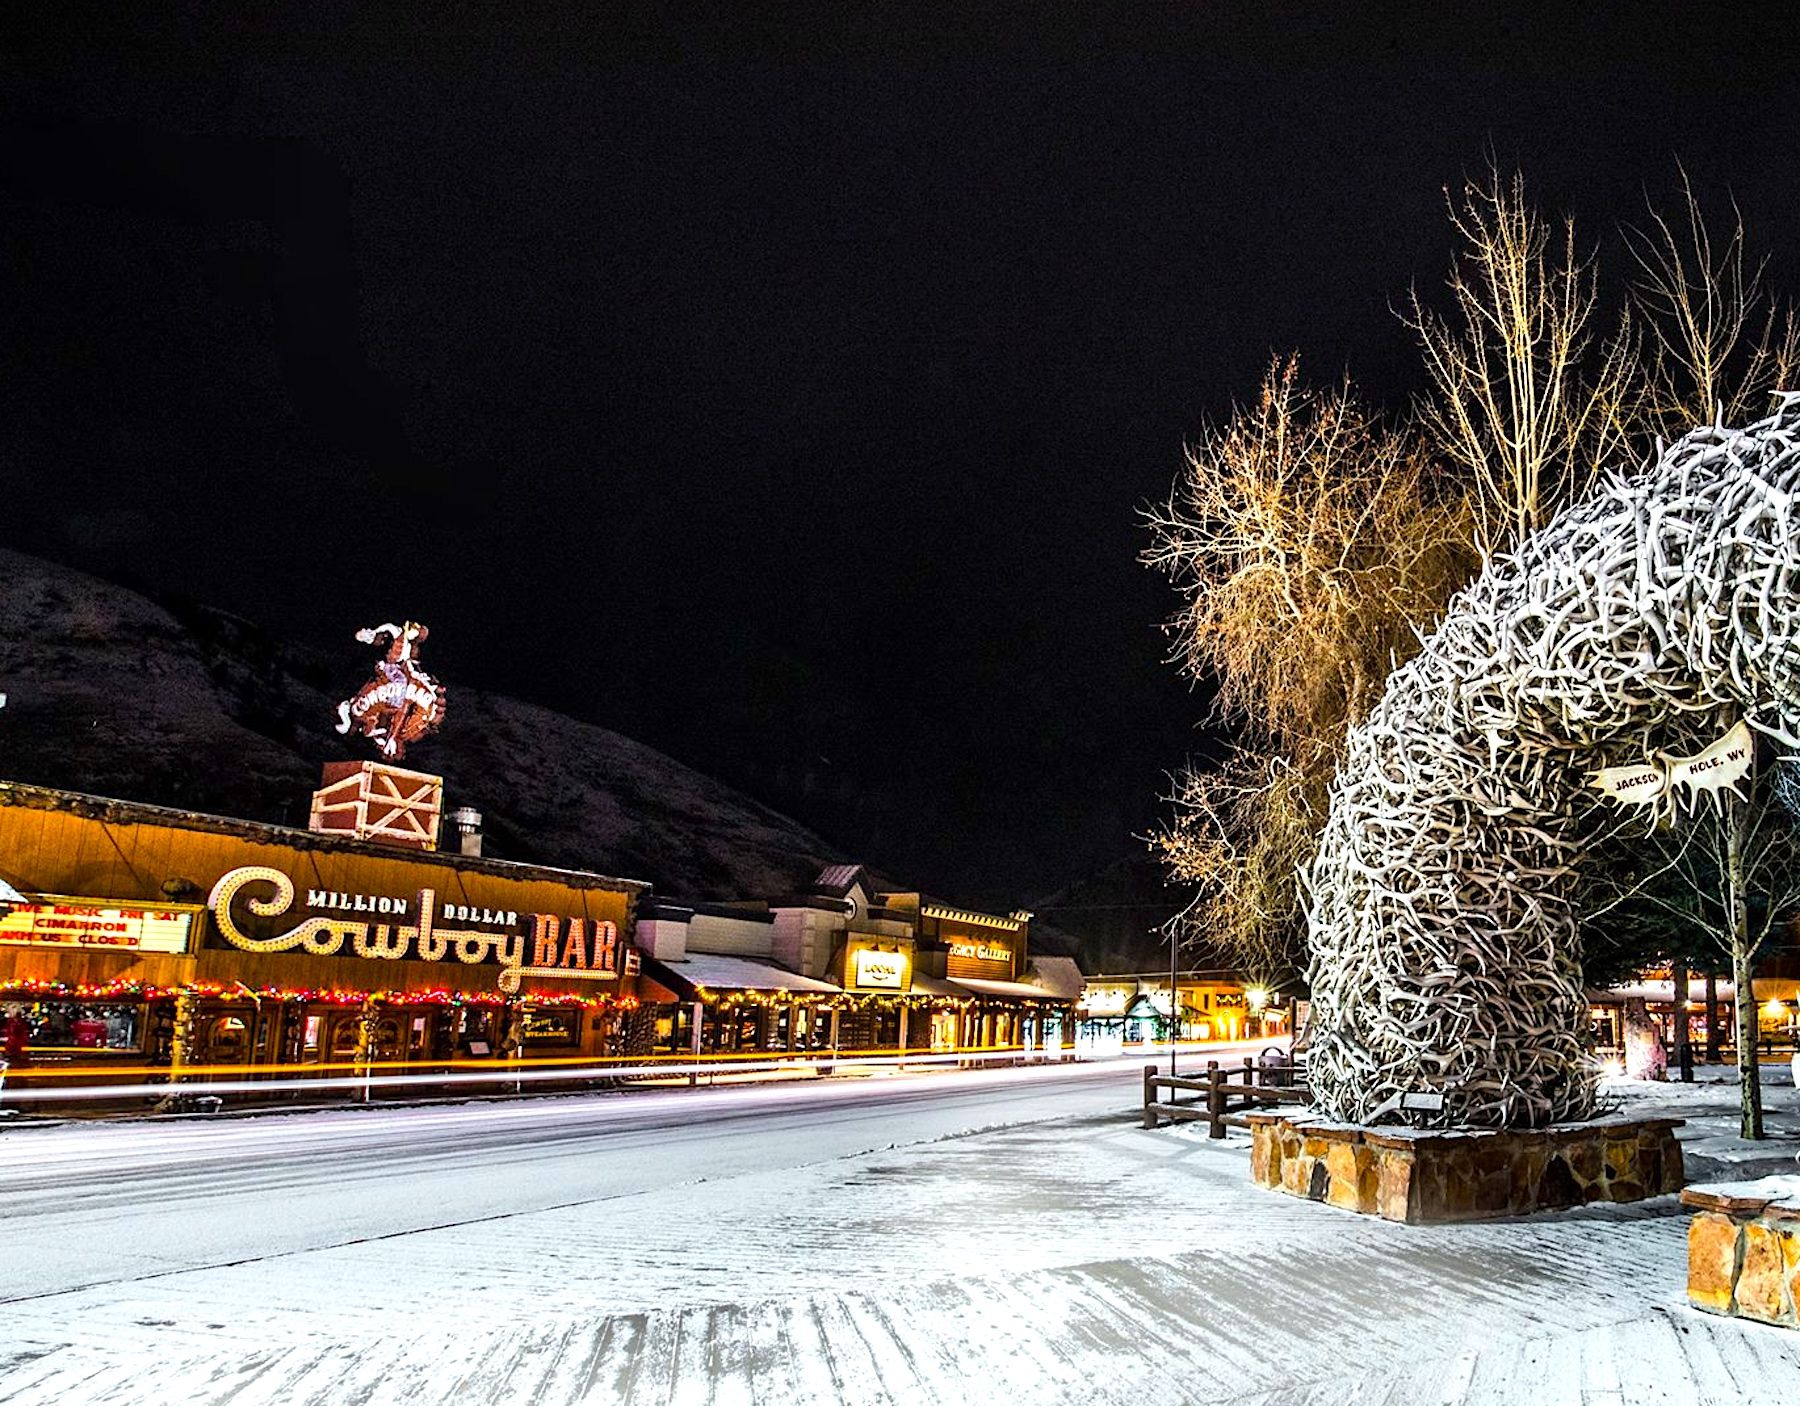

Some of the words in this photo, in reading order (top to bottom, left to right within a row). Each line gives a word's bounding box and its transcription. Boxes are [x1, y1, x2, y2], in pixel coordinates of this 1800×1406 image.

[352, 682, 404, 716] COWBOY
[1727, 748, 1745, 762] WY
[53, 905, 102, 917] MUSIC
[120, 909, 144, 920] FRI
[153, 911, 179, 921] SAT
[306, 889, 407, 914] MILLION
[443, 903, 518, 926] DOLLAR
[35, 918, 127, 932] CIMARRON
[207, 866, 618, 994] Cowboy
[533, 913, 617, 970] BAR
[79, 934, 138, 946] CLOSED
[948, 943, 976, 957] EGACY
